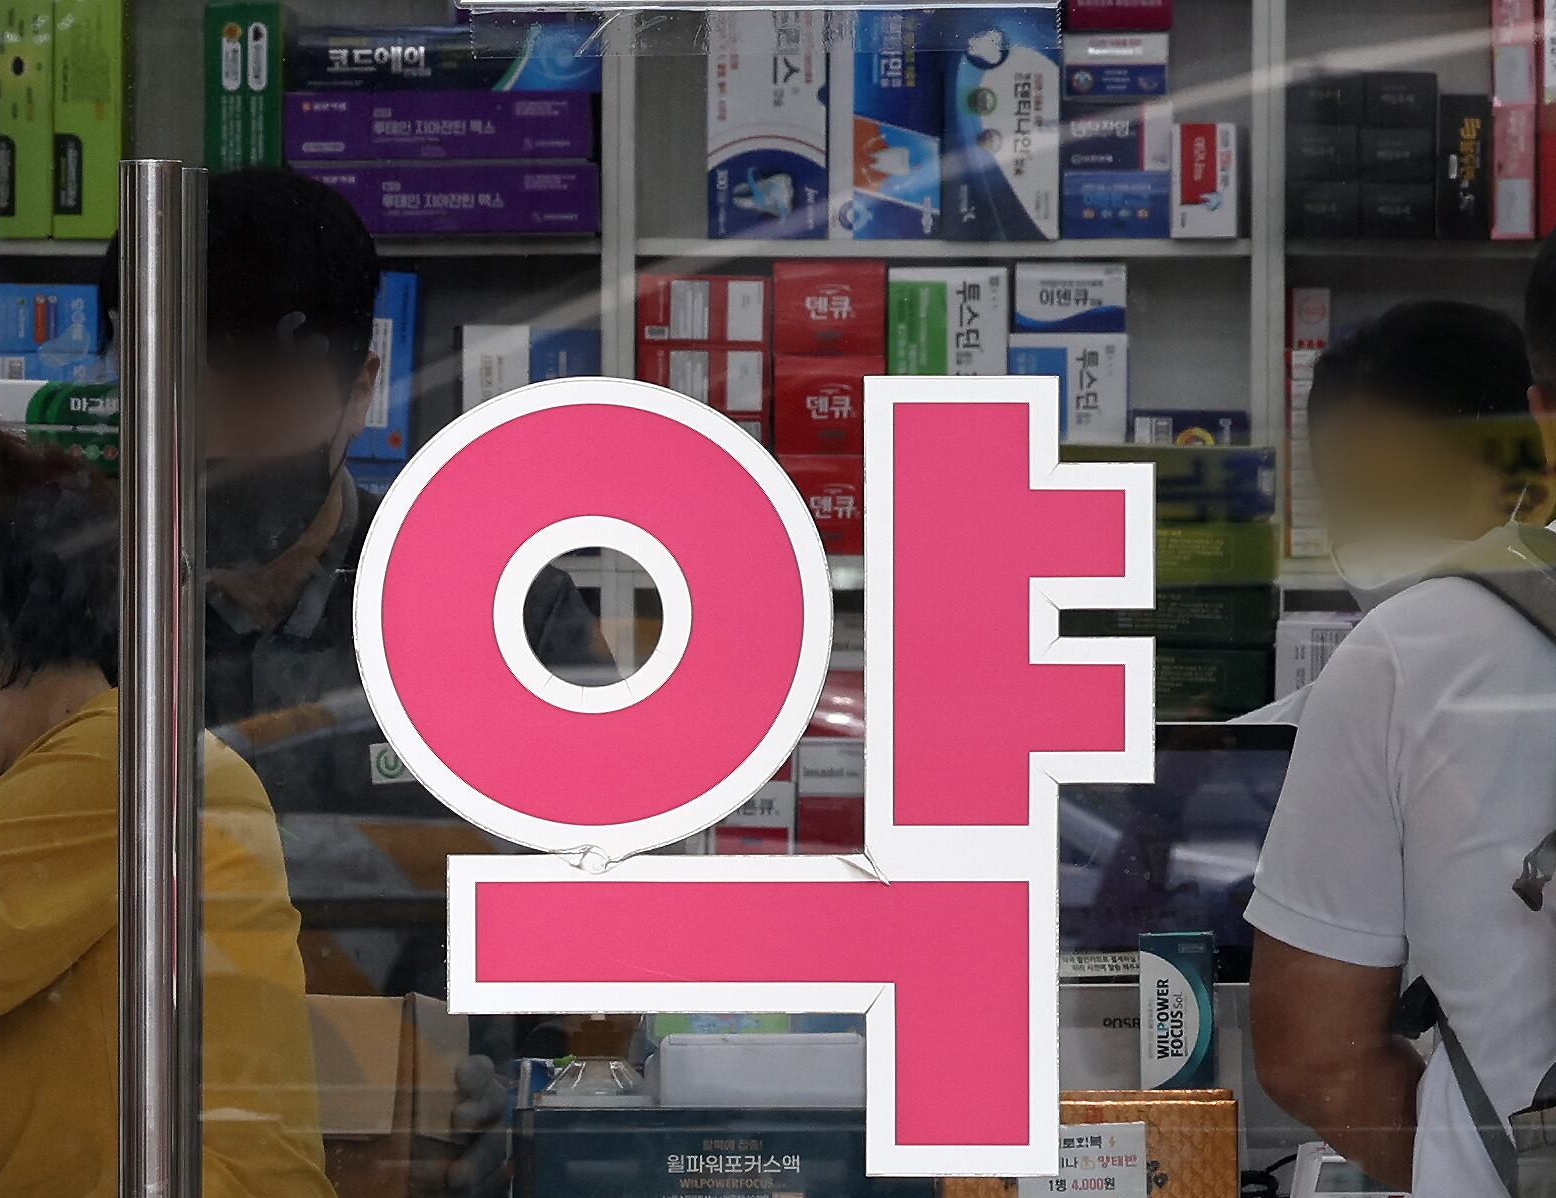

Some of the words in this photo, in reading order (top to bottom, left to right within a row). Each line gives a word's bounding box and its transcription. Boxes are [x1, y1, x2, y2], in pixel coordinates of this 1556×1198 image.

[367, 390, 1141, 1160] 약
[1156, 978, 1170, 1060] WILPOWER
[1170, 1010, 1184, 1057] FOCUS
[1059, 1135, 1103, 1149] 로회복
[1048, 1179, 1067, 1192] 1병
